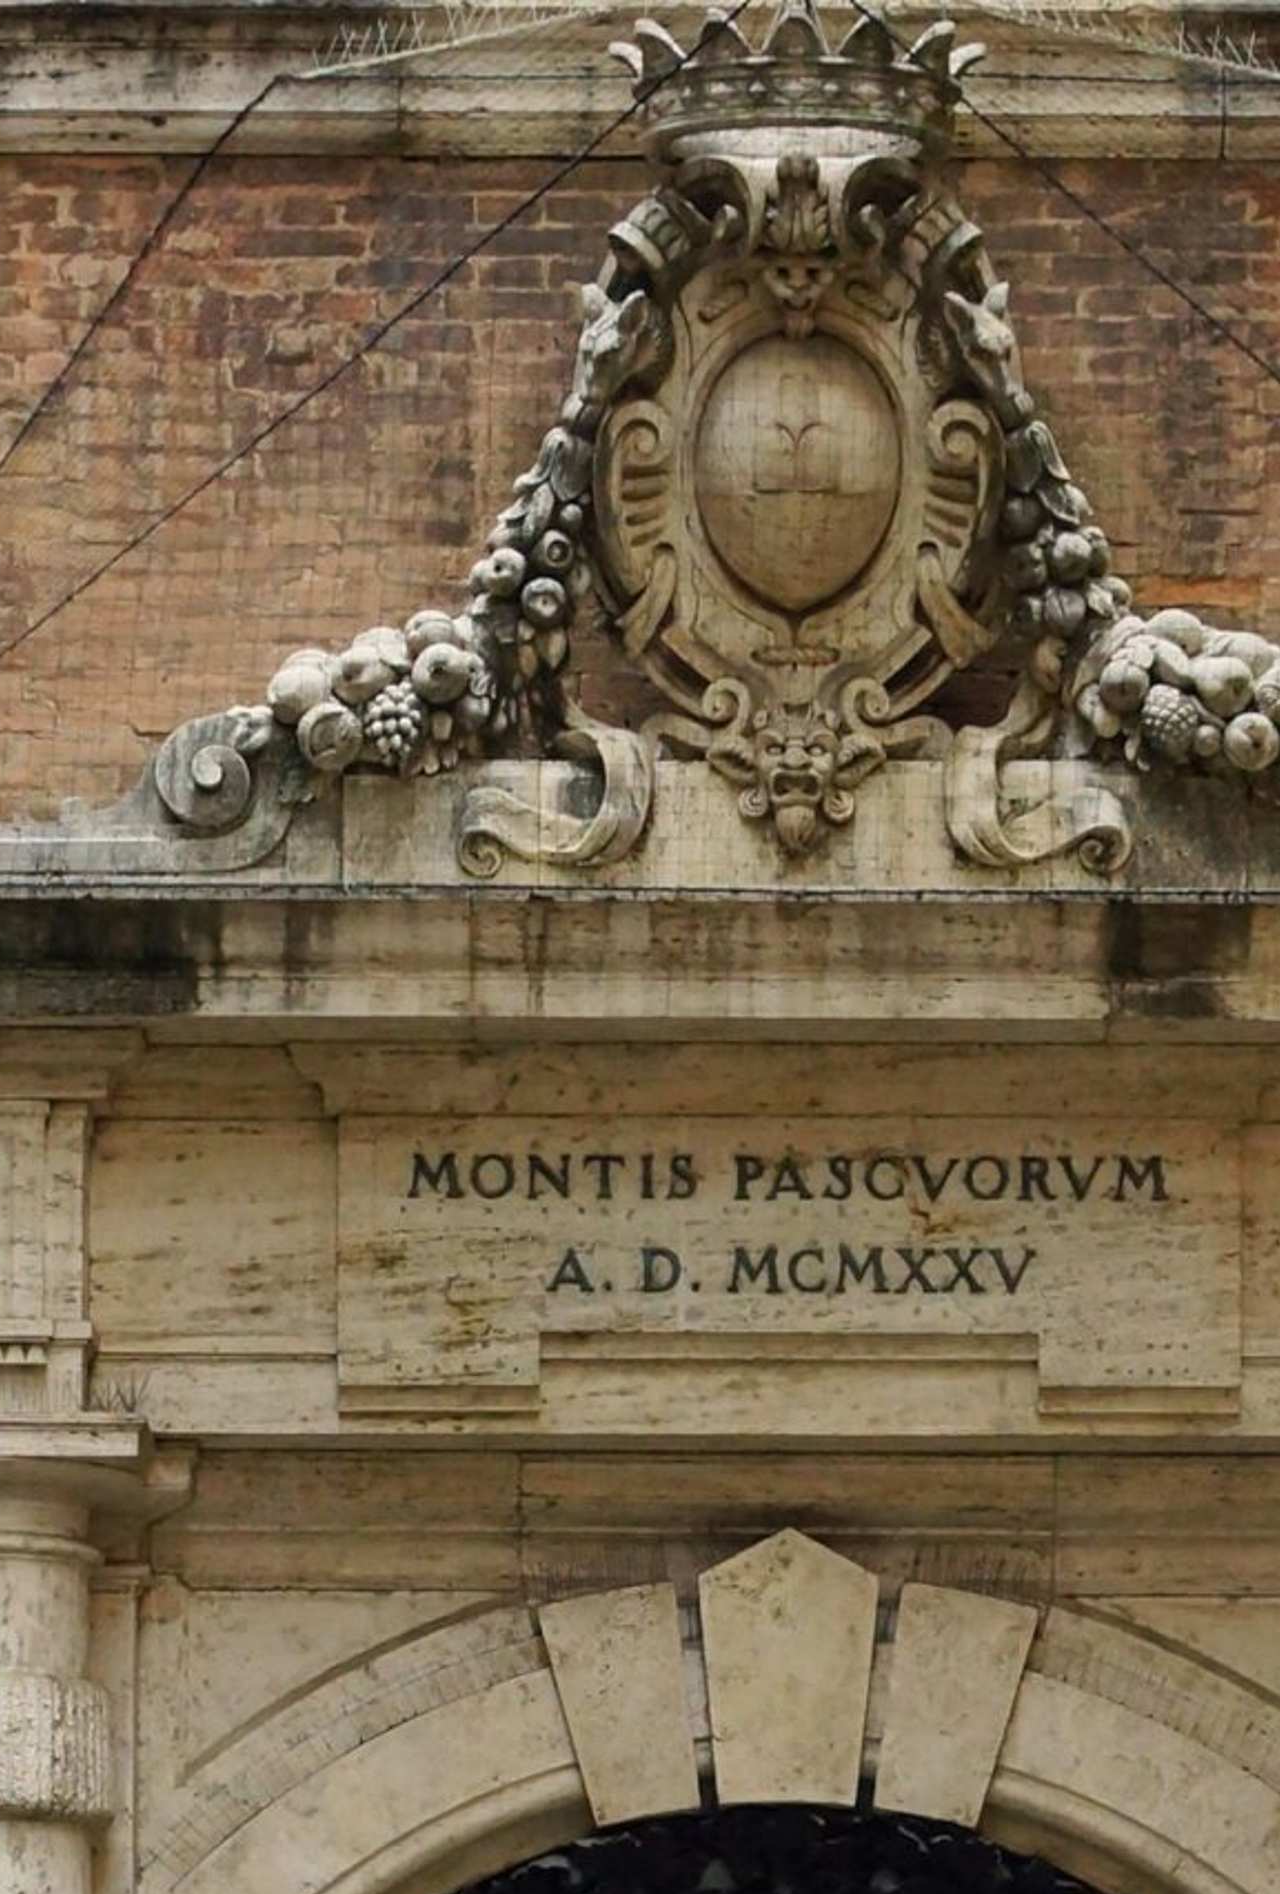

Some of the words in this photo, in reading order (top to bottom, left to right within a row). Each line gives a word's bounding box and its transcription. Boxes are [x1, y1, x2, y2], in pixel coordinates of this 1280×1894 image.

[407, 1153, 697, 1200] MONTIS
[733, 1154, 1170, 1202] PASCVORVM
[726, 1244, 1037, 1295] MCMXXV
